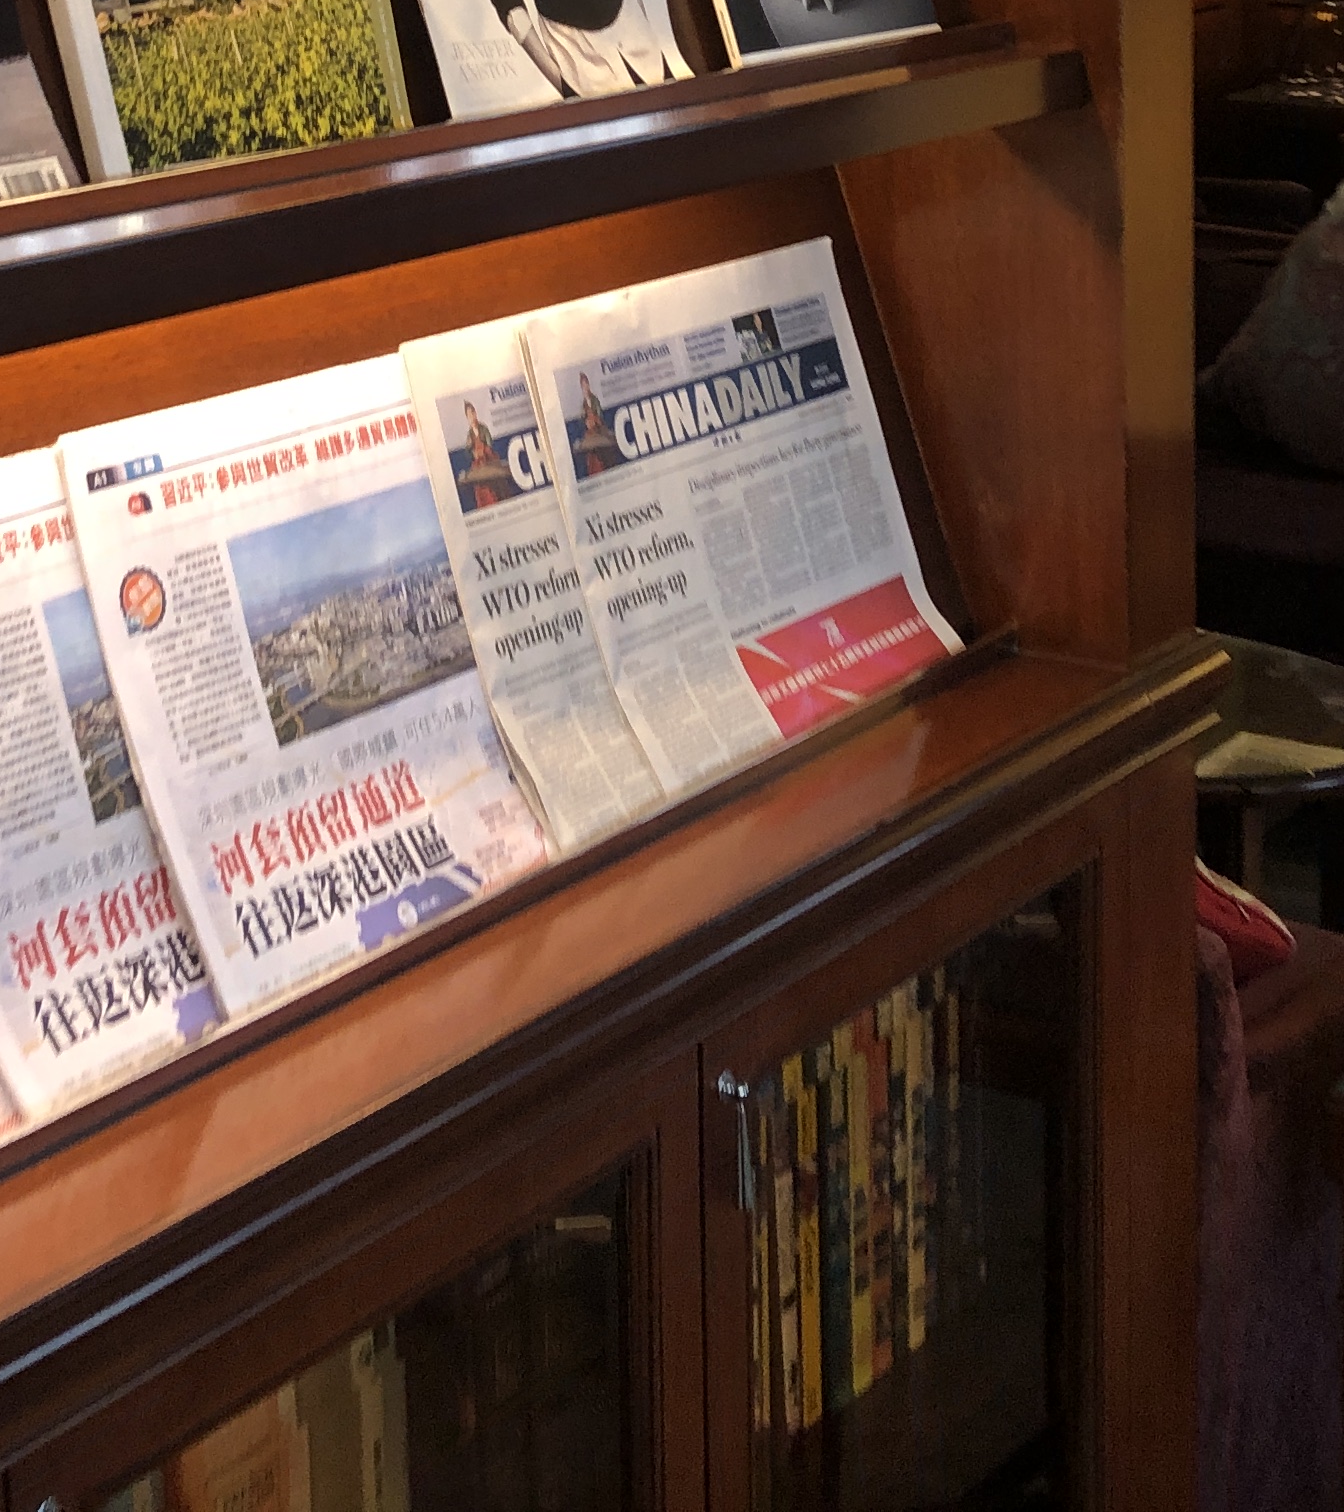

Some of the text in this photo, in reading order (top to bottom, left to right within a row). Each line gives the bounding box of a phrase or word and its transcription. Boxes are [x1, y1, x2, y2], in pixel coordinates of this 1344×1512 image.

[584, 499, 664, 545] Xi stresses
[472, 533, 560, 581] Xi stresses
[593, 544, 636, 580] WTO
[481, 579, 530, 619] WTO
